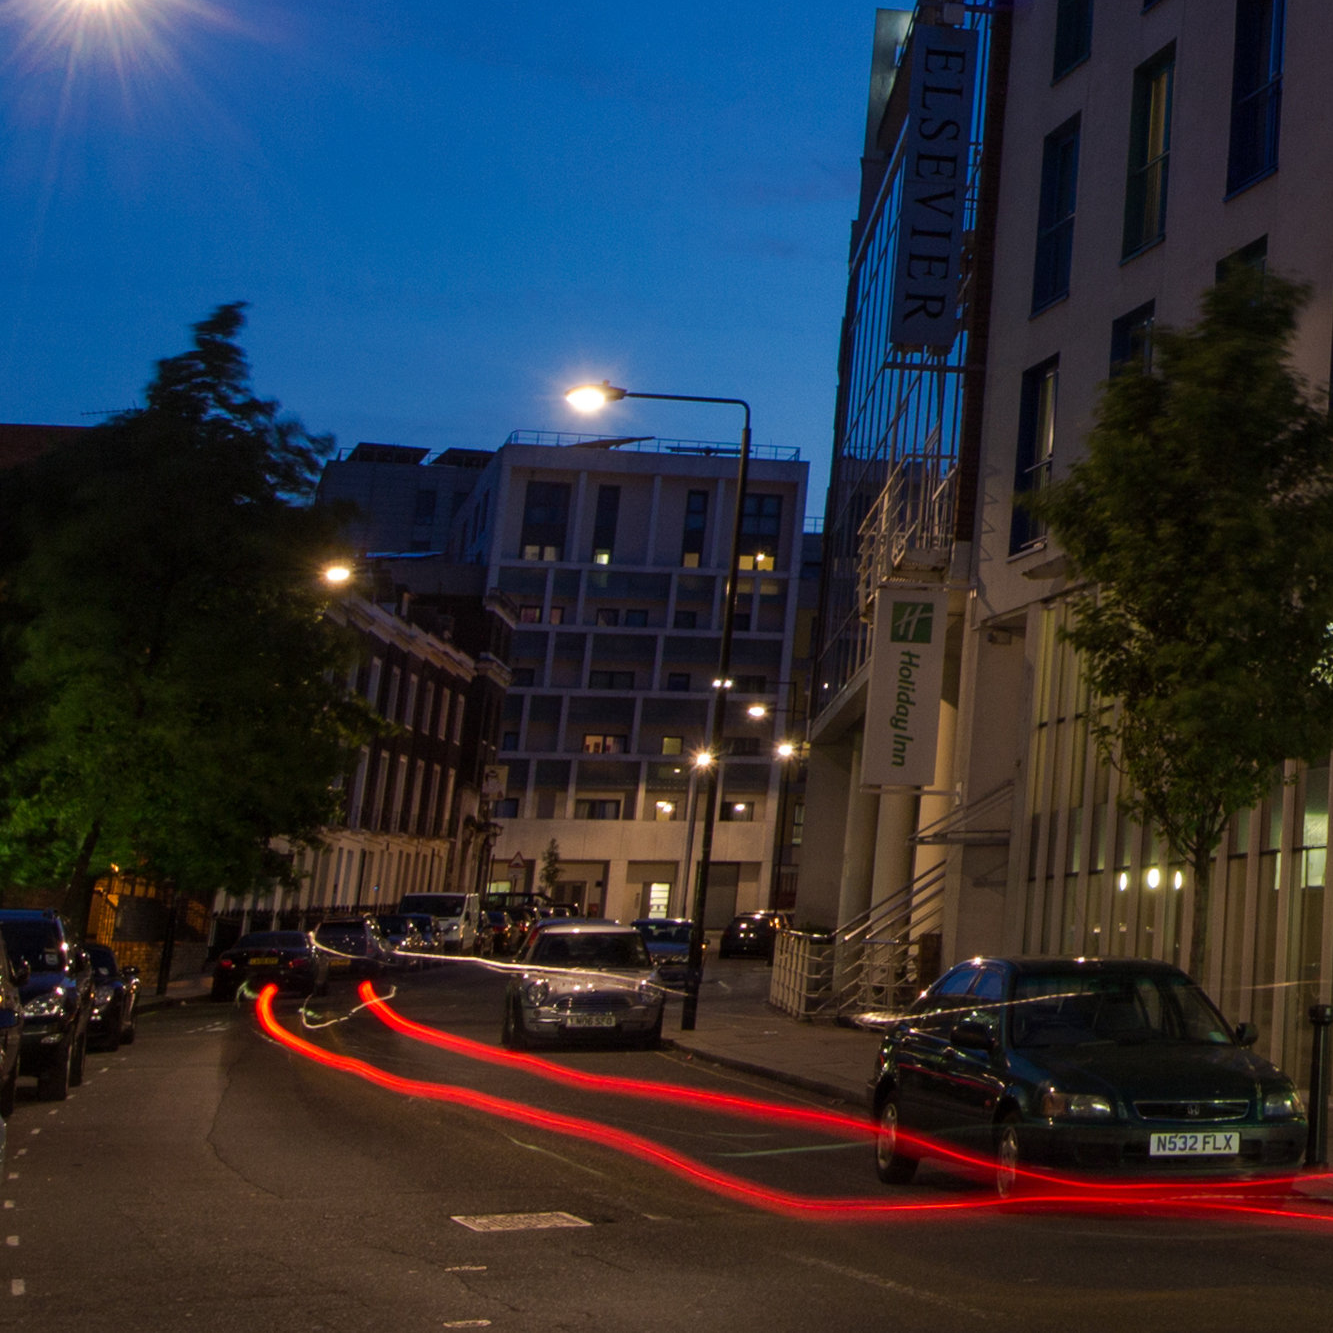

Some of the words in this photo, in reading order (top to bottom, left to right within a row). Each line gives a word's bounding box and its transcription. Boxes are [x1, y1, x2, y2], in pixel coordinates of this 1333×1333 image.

[904, 46, 965, 324] ELSEVIER
[890, 651, 920, 732] Holiday
[891, 734, 914, 767] Inn
[1157, 1135, 1198, 1152] N532
[1202, 1134, 1233, 1151] FLX
